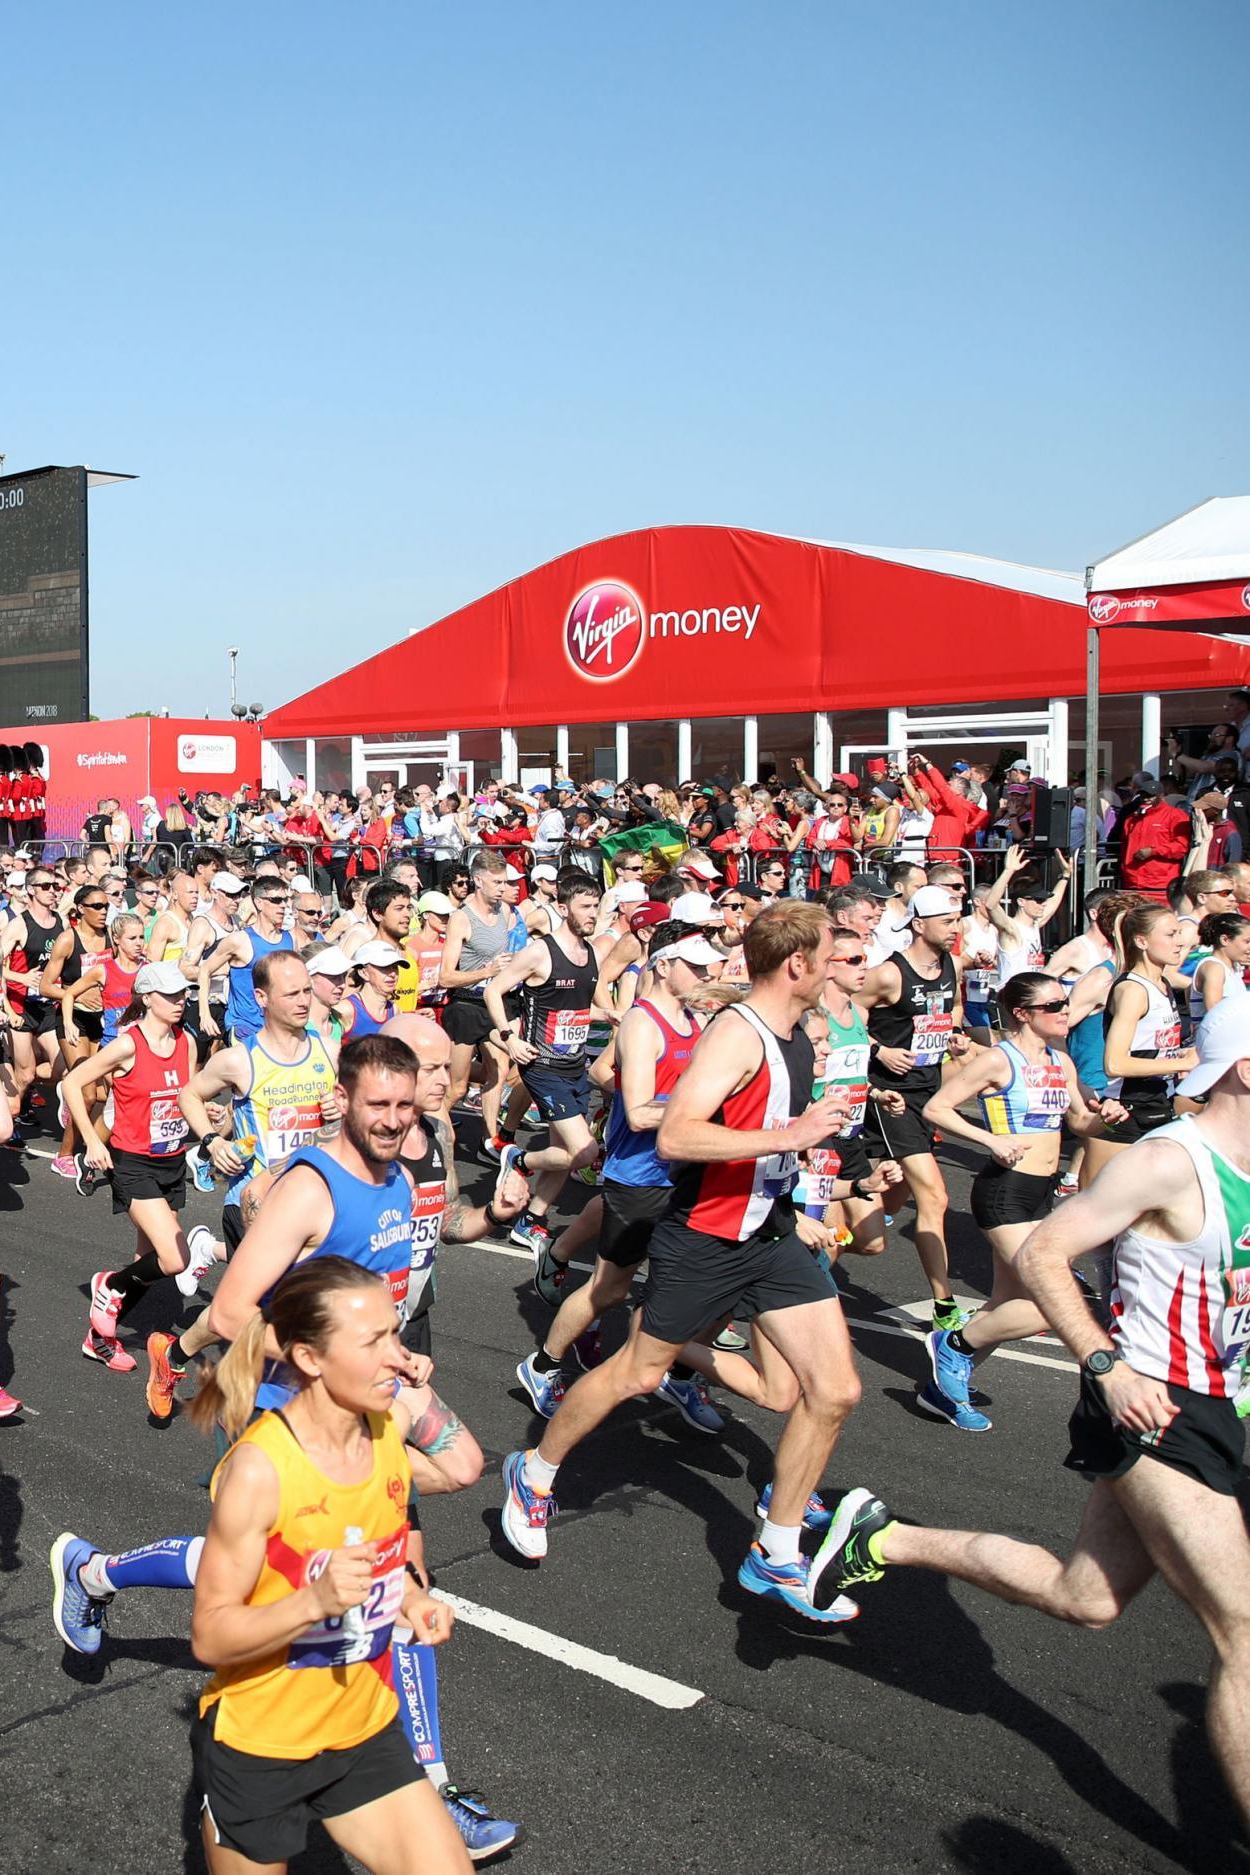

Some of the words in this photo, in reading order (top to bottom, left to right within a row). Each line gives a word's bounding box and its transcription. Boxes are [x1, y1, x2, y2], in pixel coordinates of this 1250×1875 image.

[1120, 598, 1159, 611] money
[573, 595, 638, 664] Virgin
[650, 604, 761, 639] money
[555, 979, 576, 987] BRAT
[561, 1026, 586, 1041] 1695
[164, 1069, 180, 1087] H
[263, 1081, 328, 1097] Headington
[1041, 1090, 1066, 1109] 440
[378, 1209, 393, 1230] CITY
